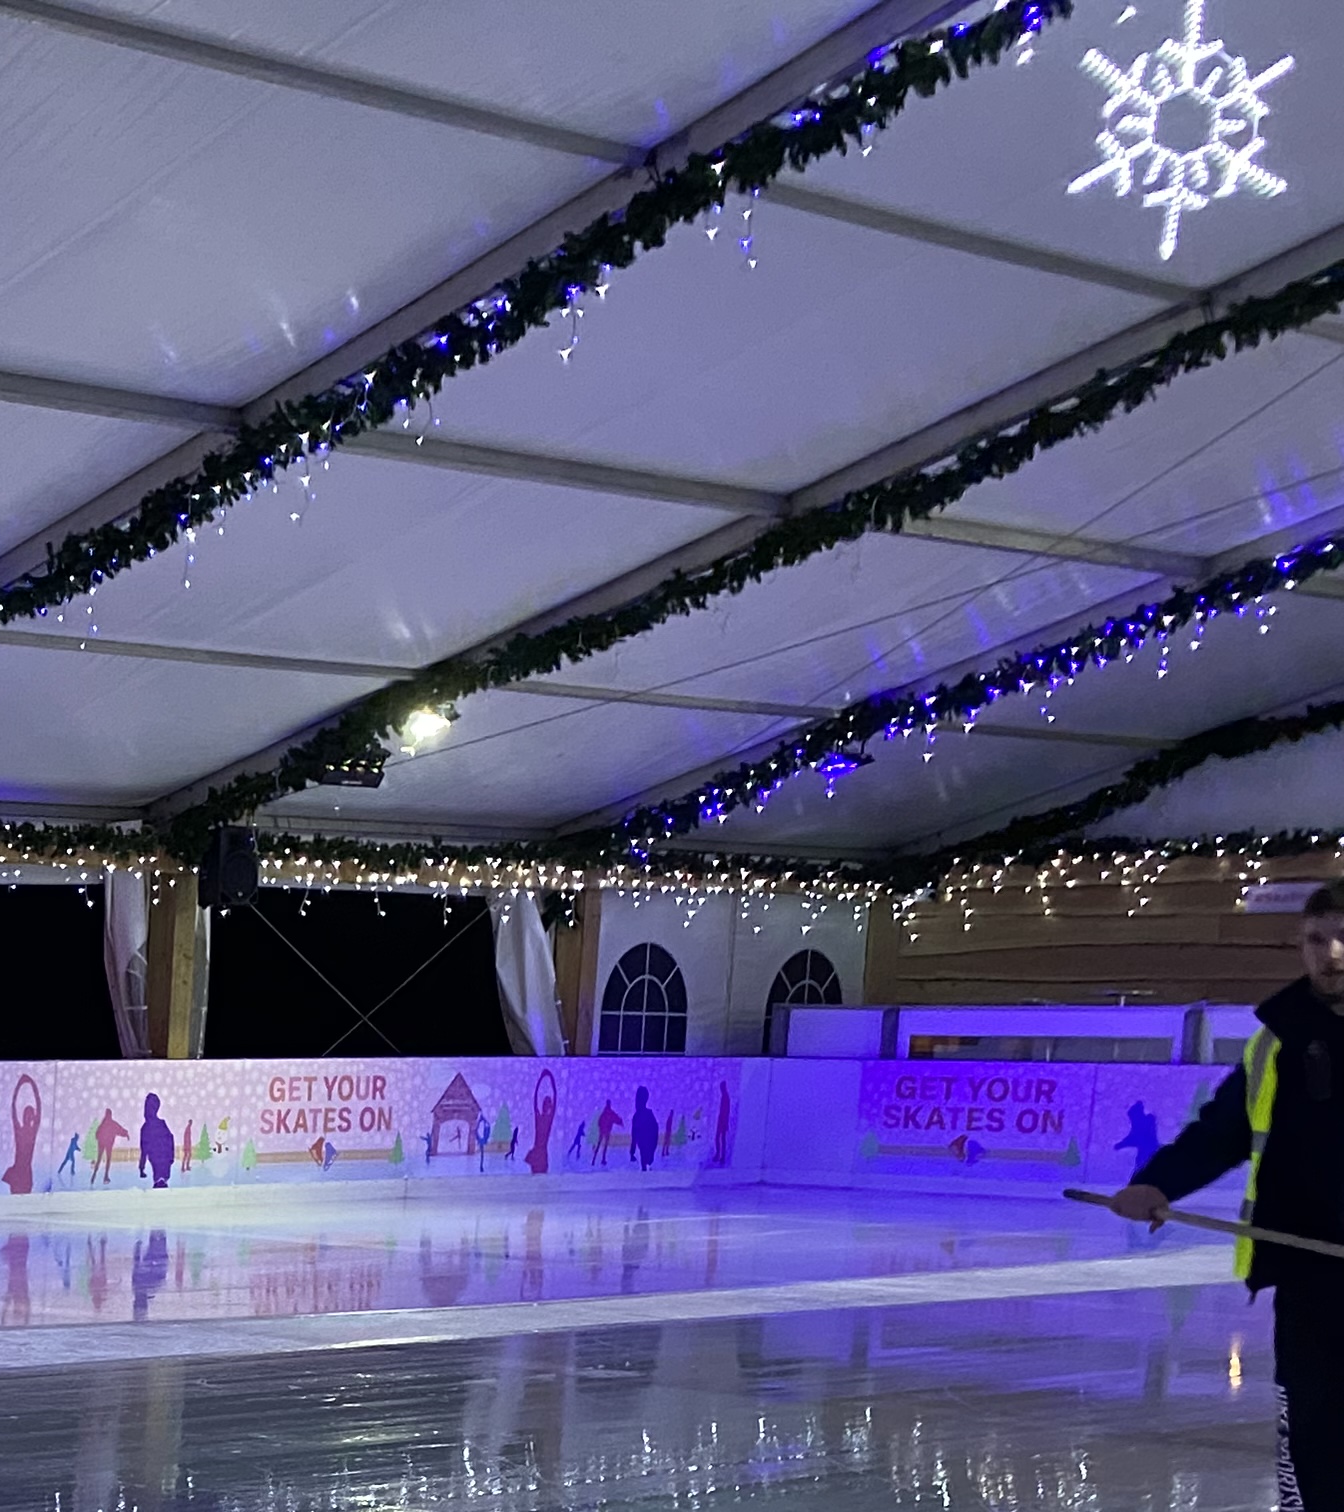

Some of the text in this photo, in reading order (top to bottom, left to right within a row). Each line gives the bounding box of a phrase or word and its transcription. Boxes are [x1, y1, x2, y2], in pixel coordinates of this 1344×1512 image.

[269, 1074, 387, 1102] GET YOUR
[895, 1075, 1058, 1104] GET YOUR
[259, 1105, 393, 1135] SKATES ON
[882, 1105, 1066, 1135] SKATES ON
